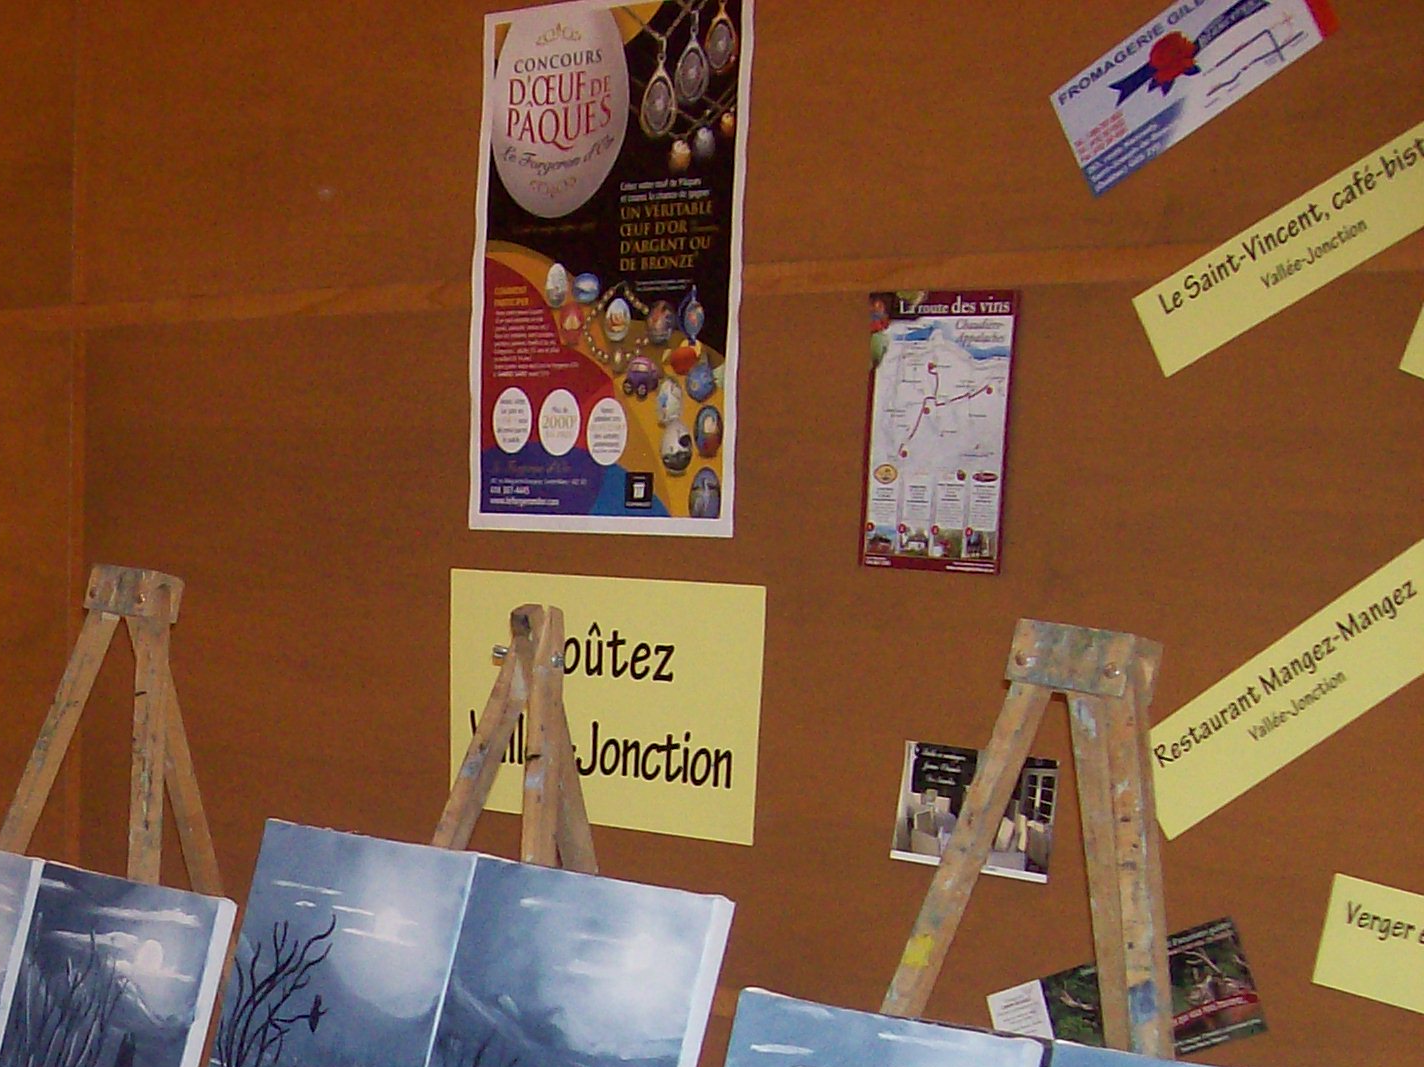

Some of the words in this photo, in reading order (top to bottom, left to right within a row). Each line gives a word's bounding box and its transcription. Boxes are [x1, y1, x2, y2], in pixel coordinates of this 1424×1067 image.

[514, 49, 602, 74] CONCOURS
[1057, 25, 1165, 106] FROMAGERIE
[506, 94, 612, 151] PÂQUES
[1157, 289, 1183, 315] Le
[1183, 203, 1331, 299] Saint-Vincent,
[1260, 218, 1368, 289] Vallée-Jonction
[899, 300, 916, 314] La
[951, 295, 977, 314] des
[979, 296, 1010, 314] vins
[563, 622, 675, 682] oûtez
[1153, 686, 1262, 768] Restaurant
[1259, 580, 1418, 695] Mangez-Mangez
[1247, 670, 1347, 741] Vallée-Jonction
[1346, 900, 1415, 942] Verger
